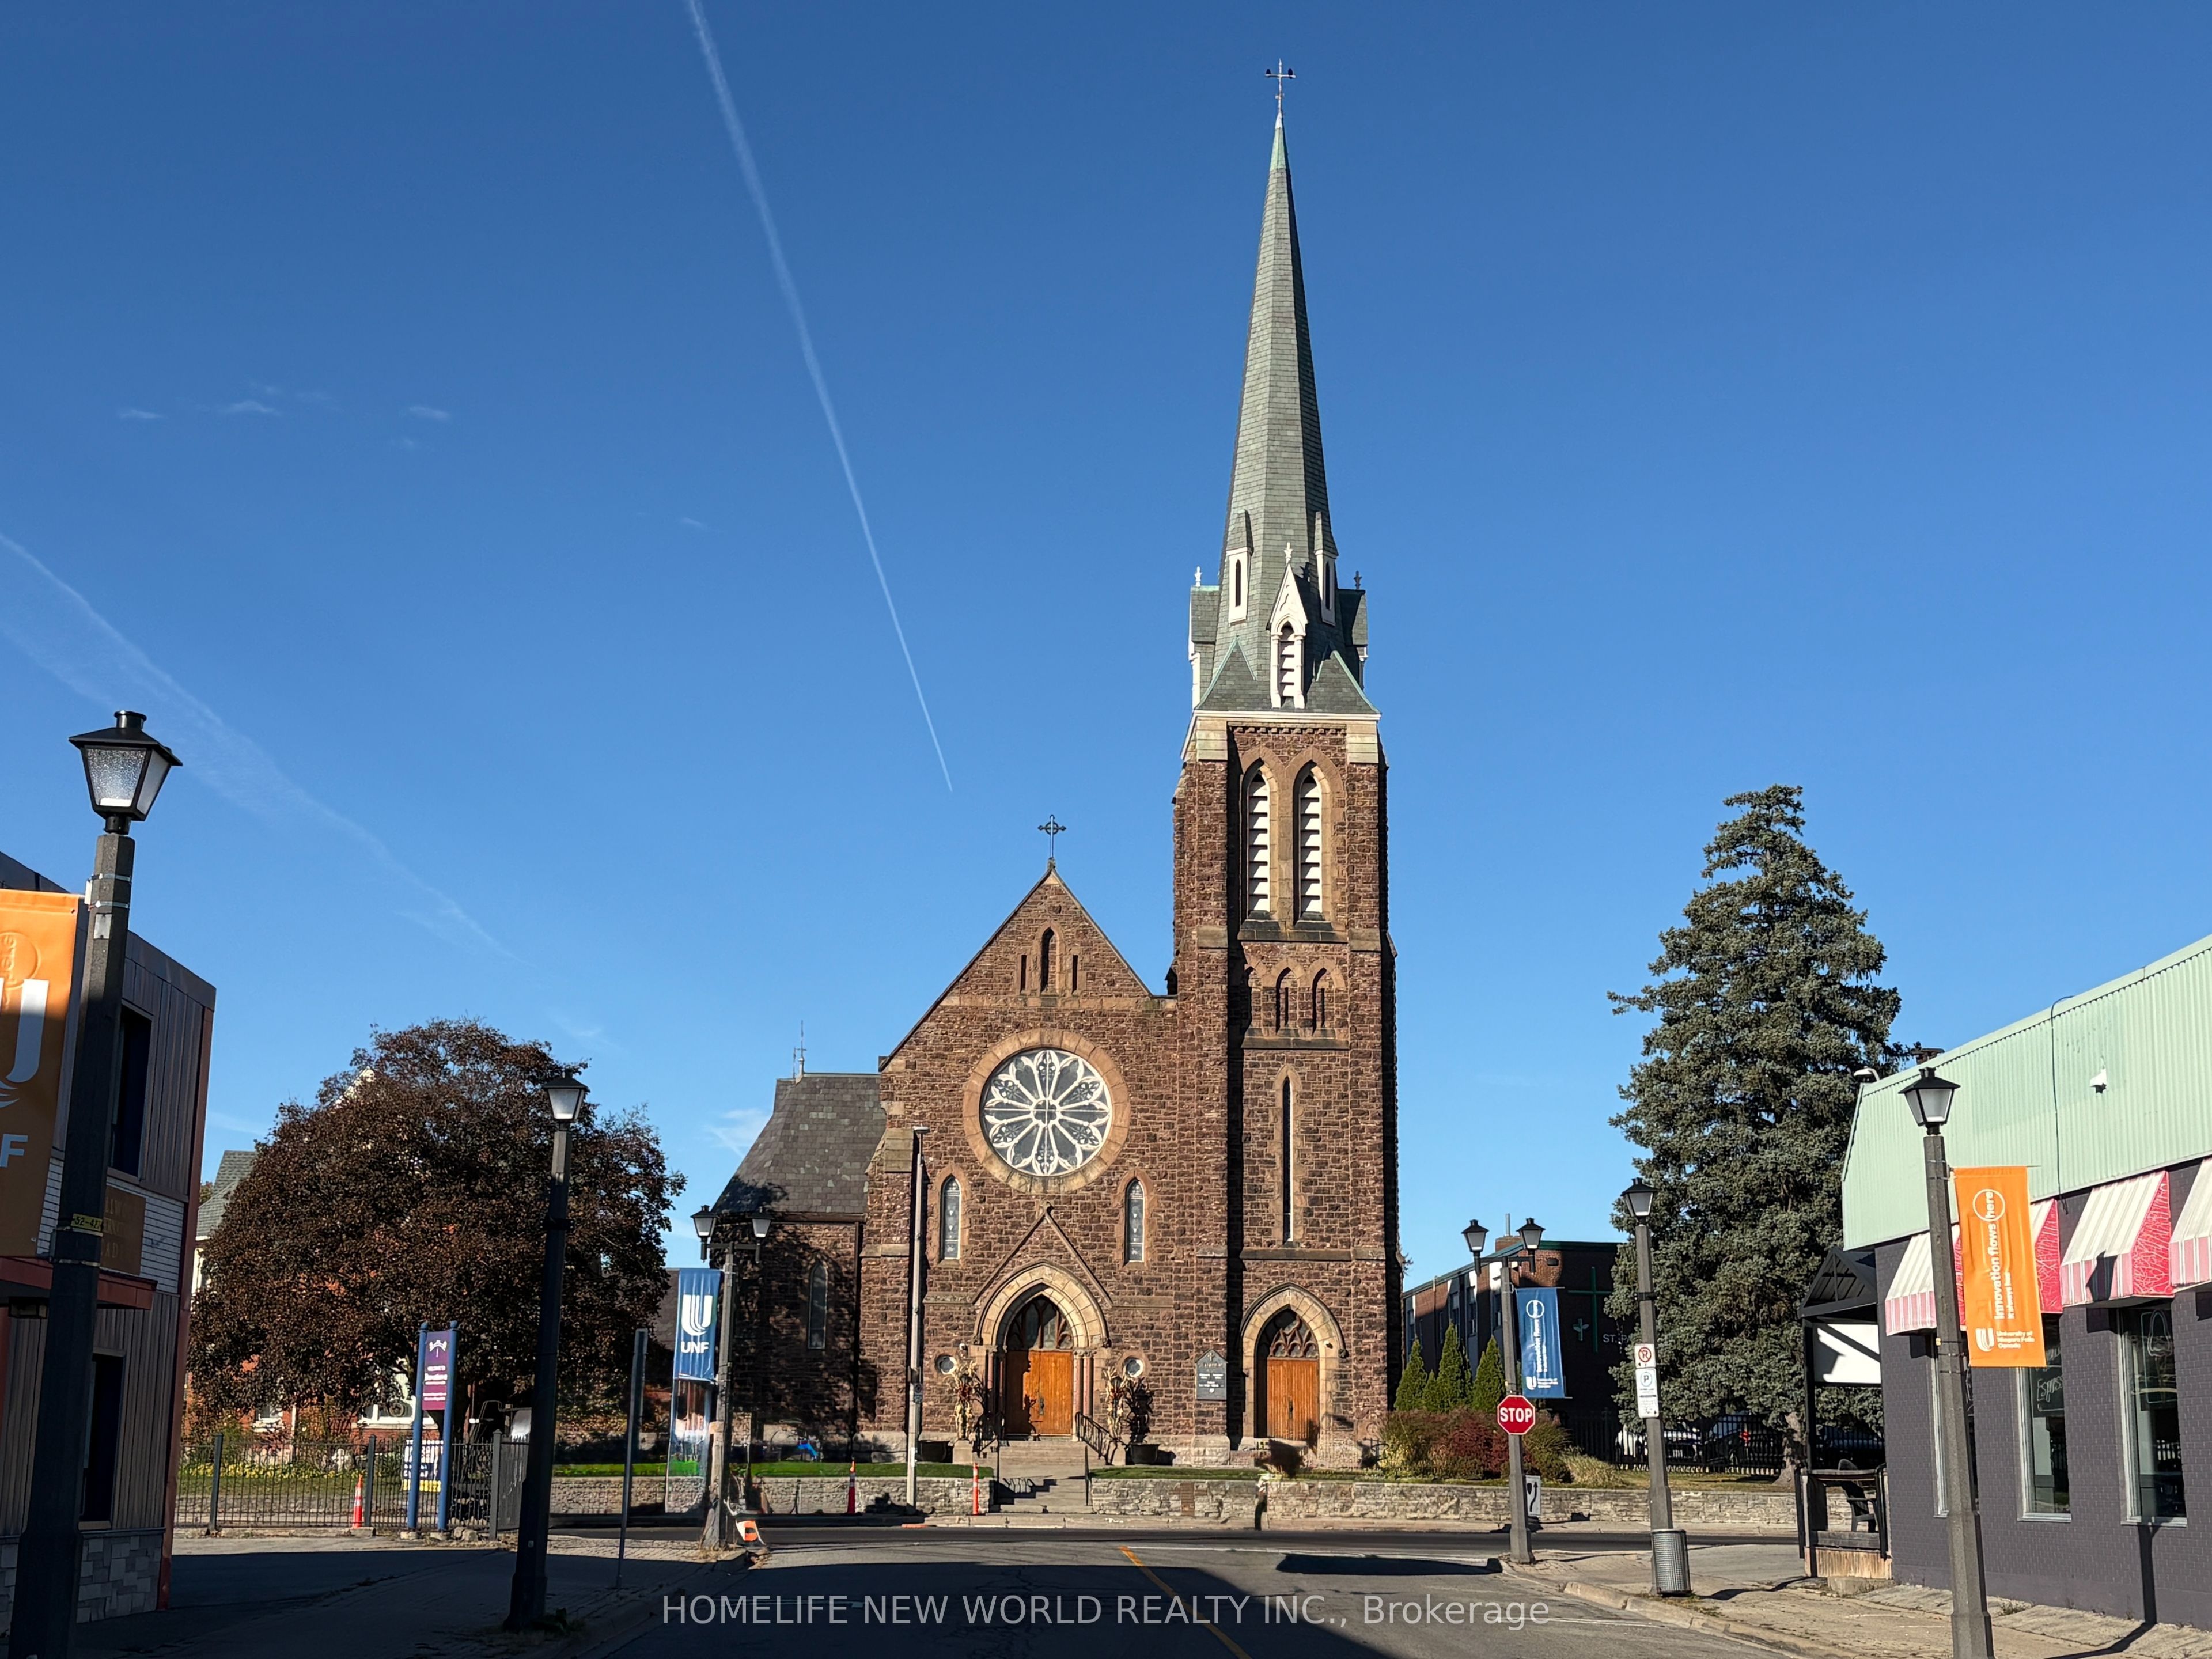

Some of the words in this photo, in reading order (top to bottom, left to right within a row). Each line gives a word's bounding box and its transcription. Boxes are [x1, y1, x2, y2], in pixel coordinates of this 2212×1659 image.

[1985, 1191, 1995, 1219] here
[1988, 1223, 1999, 1256] flows
[1990, 1257, 2005, 1320] Innovation
[681, 1341, 709, 1354] UNF
[1603, 1334, 1618, 1343] ST.
[1500, 1407, 1532, 1423] STOP
